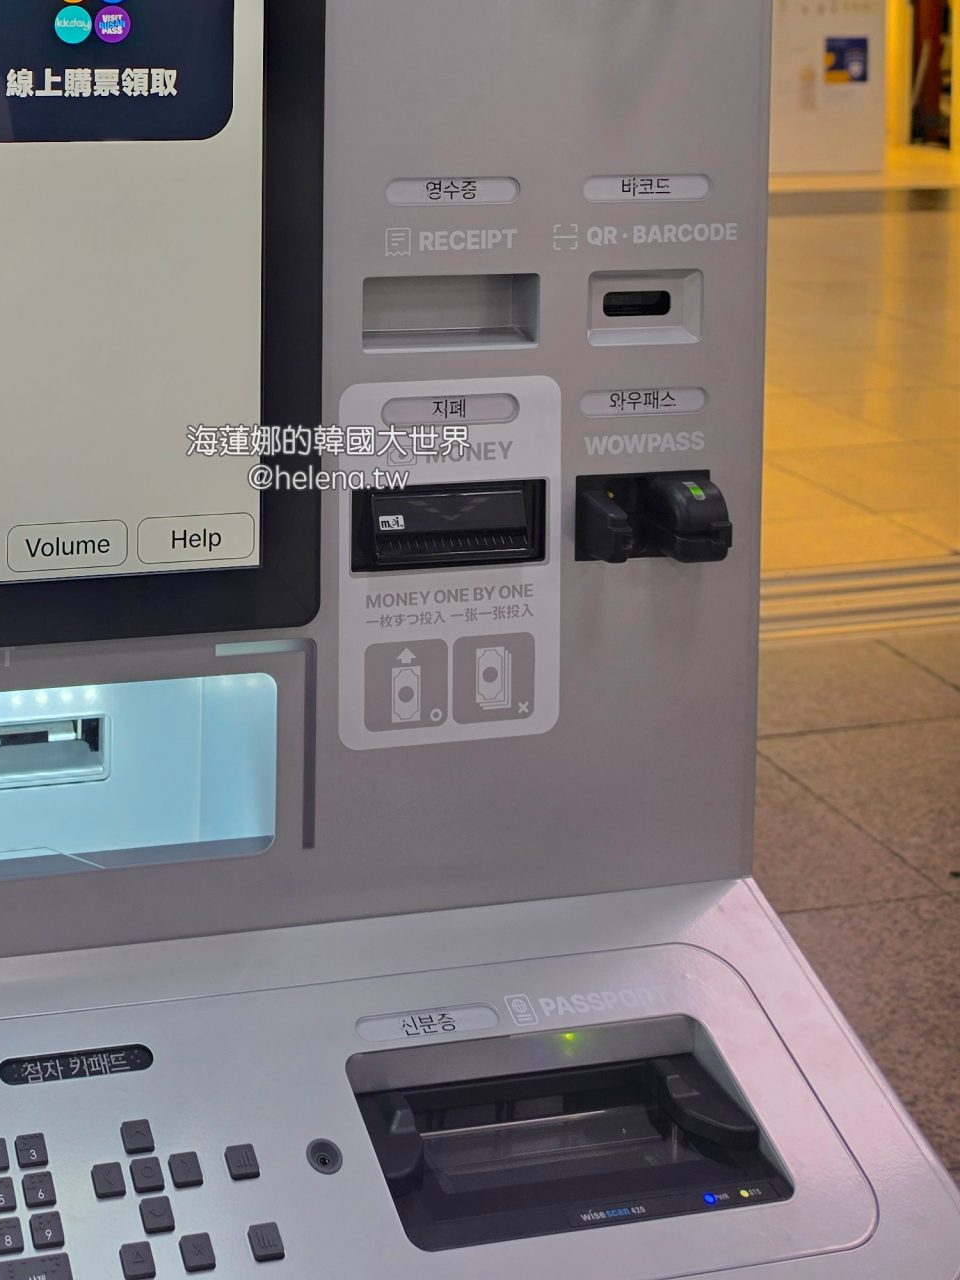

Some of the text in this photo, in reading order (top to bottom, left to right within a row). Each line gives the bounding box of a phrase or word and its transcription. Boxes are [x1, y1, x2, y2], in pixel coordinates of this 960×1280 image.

[102, 14, 123, 22] VISIT
[101, 26, 123, 34] PASS
[6, 69, 177, 98] 線上購票領取
[426, 180, 477, 200] 영수증
[621, 177, 671, 196] 바코드
[419, 228, 518, 251] RECEIPT
[432, 398, 466, 419] 지폐
[609, 390, 677, 411] 와우패스
[583, 431, 705, 456] WOWPASS
[25, 533, 111, 559] Volume
[171, 526, 222, 553] Help
[366, 583, 534, 609] MONEY ONE BY ONE
[366, 604, 534, 629] 一枚ずつ投入 一张一张投入
[539, 985, 667, 1017] PASSPORT
[401, 1013, 456, 1036] 신분증
[22, 1052, 131, 1084] 점자 키패드
[29, 1149, 37, 1160] 3
[38, 1188, 45, 1199] 6
[4, 1235, 12, 1246] 8
[44, 1230, 51, 1241] 9
